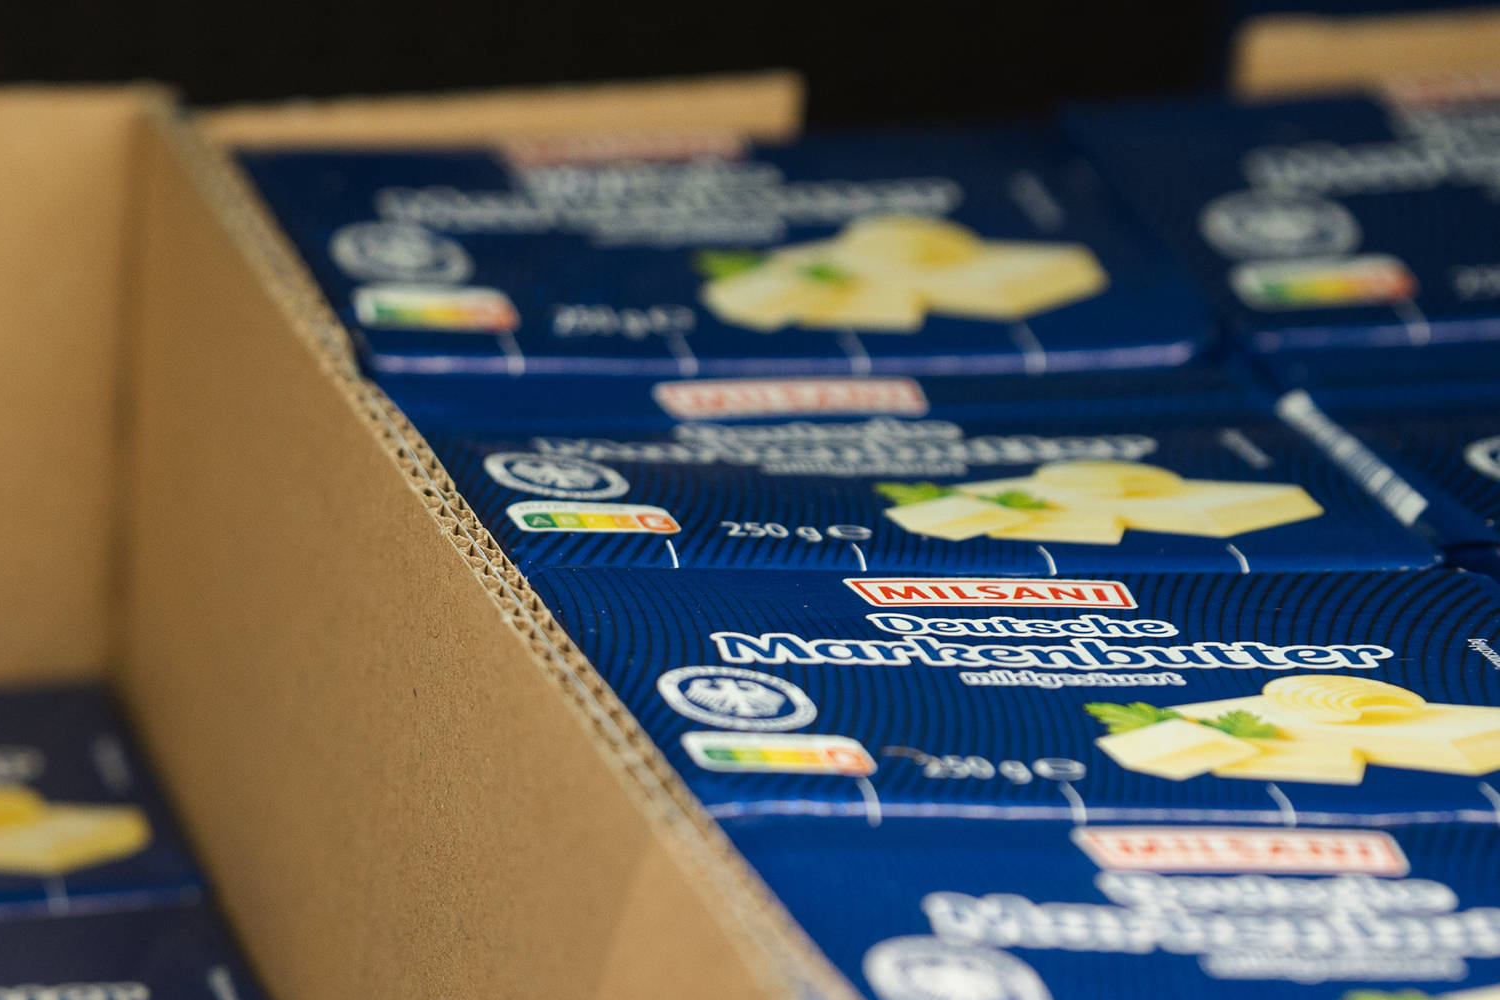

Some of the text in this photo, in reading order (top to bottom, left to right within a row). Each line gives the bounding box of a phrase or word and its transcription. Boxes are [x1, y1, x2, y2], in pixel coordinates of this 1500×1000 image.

[720, 521, 823, 543] 250 g
[877, 585, 1111, 602] MILSANI
[864, 612, 1180, 638] Deutsche
[709, 631, 1395, 669] Markenbutter
